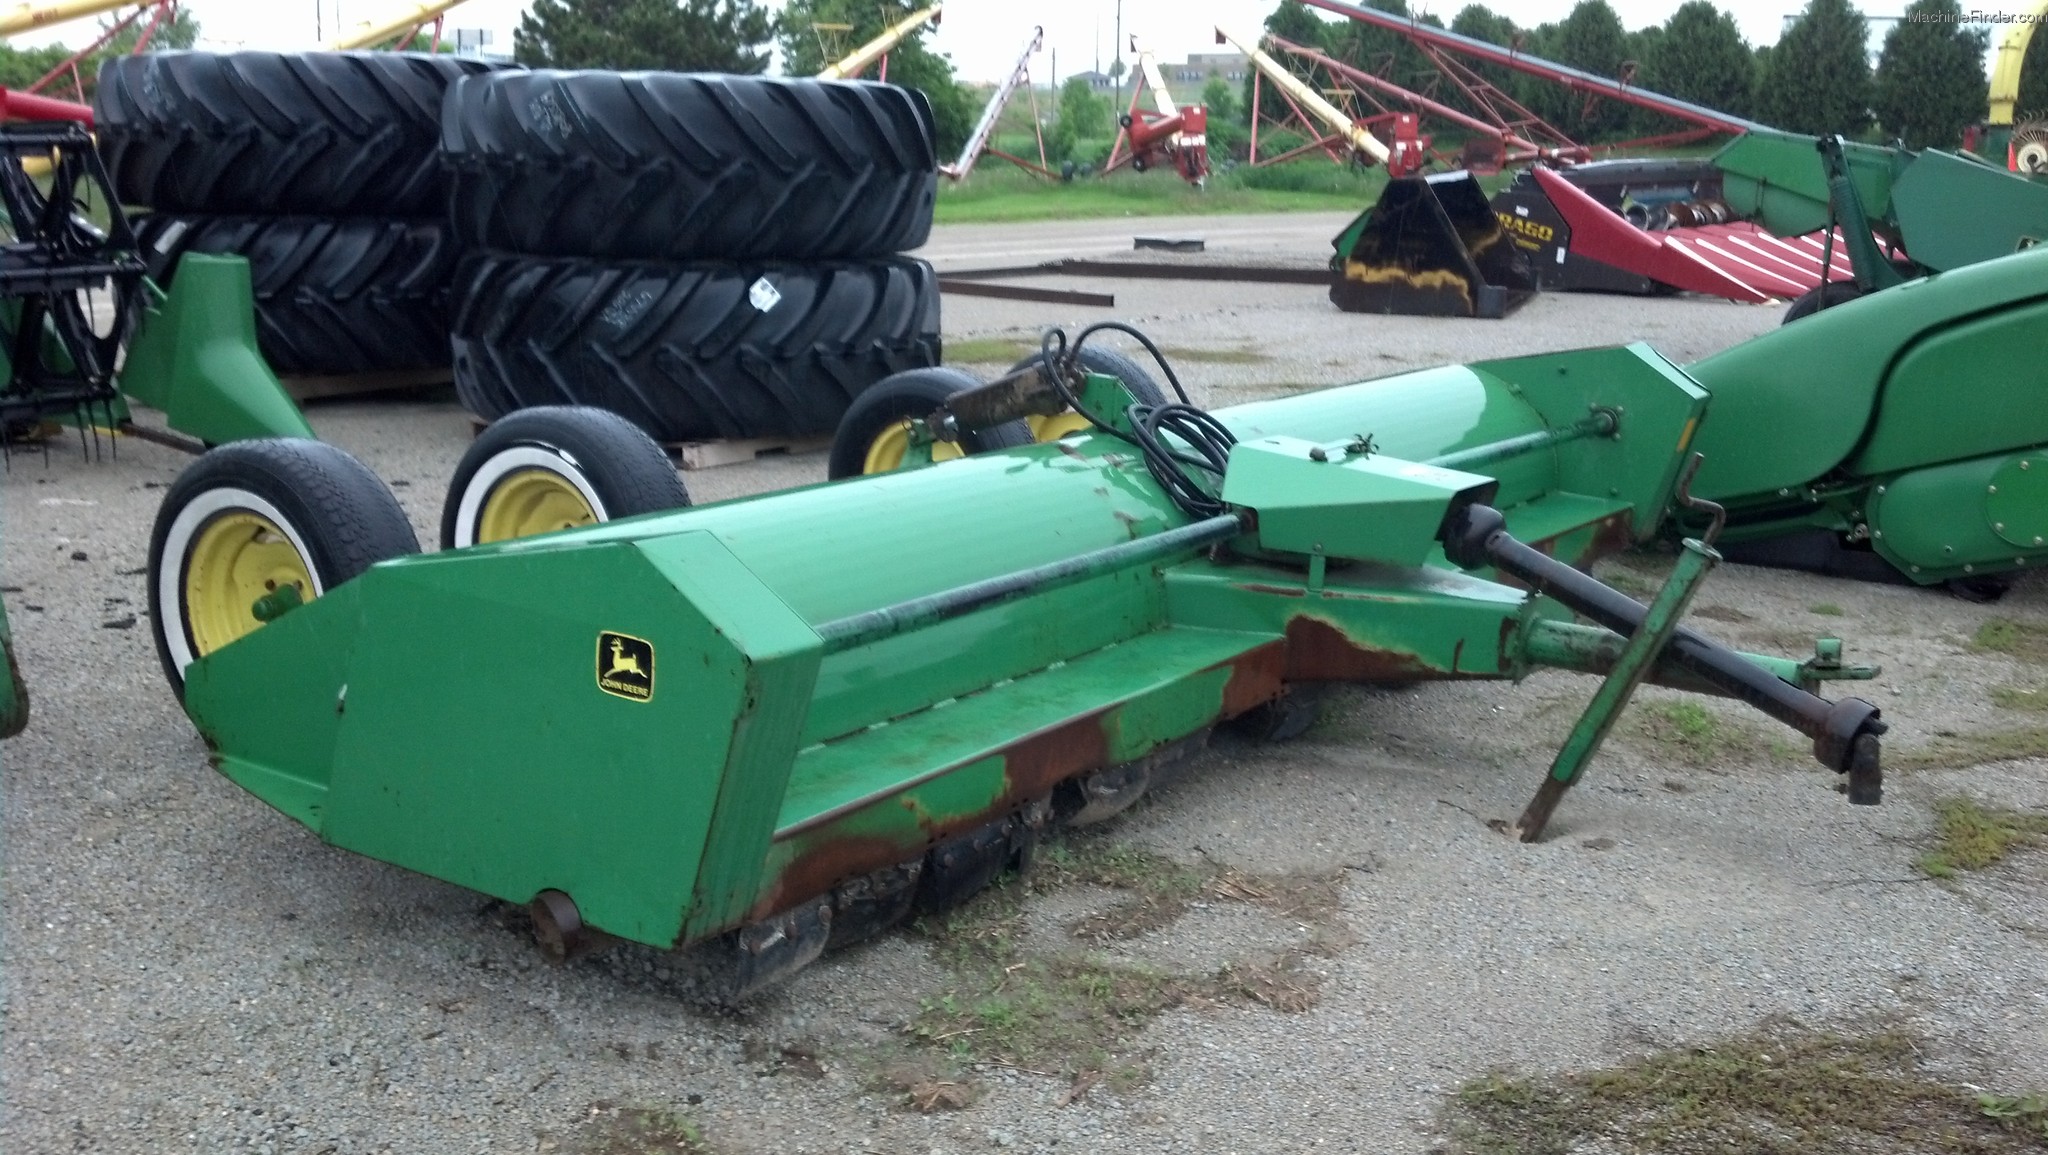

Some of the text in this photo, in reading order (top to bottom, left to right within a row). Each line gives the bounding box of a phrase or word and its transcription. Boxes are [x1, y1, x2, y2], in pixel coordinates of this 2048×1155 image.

[1496, 212, 1553, 241] RAGO
[601, 678, 648, 697] JOHN DEERE
